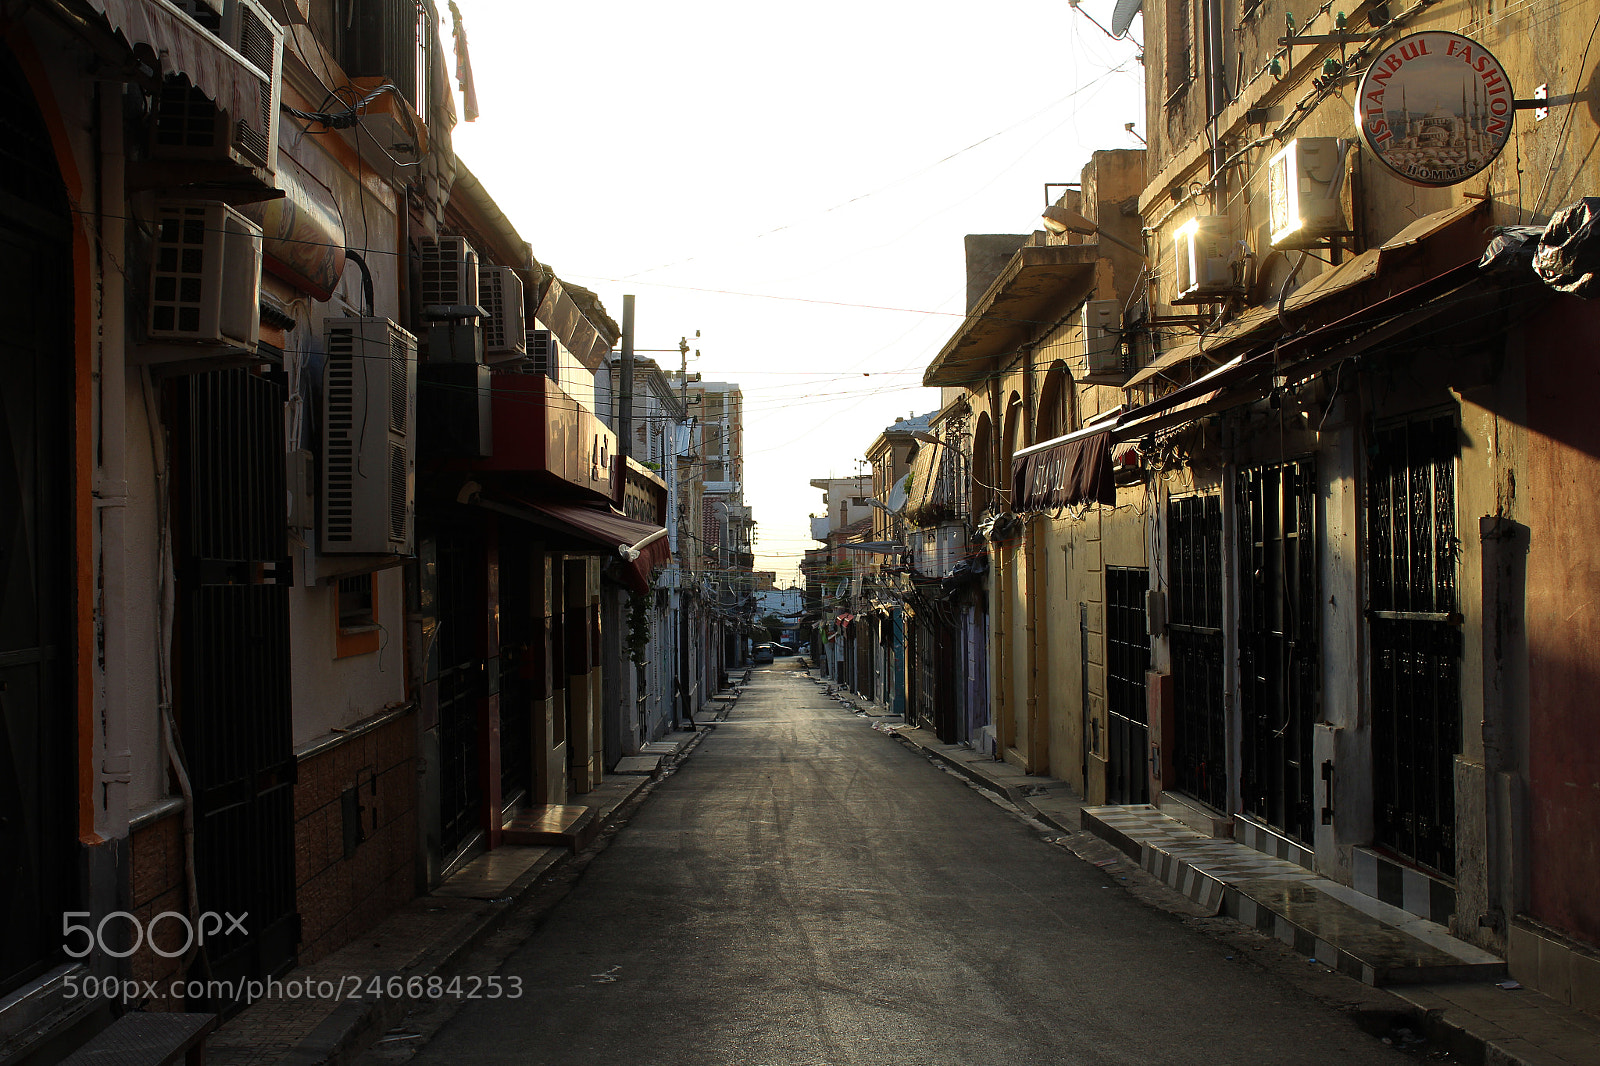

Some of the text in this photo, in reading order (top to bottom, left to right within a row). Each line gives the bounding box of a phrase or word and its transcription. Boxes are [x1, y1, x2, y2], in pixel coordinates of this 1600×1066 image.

[1366, 39, 1508, 144] ISTANBUL FASHION
[1406, 162, 1476, 180] HOMMES
